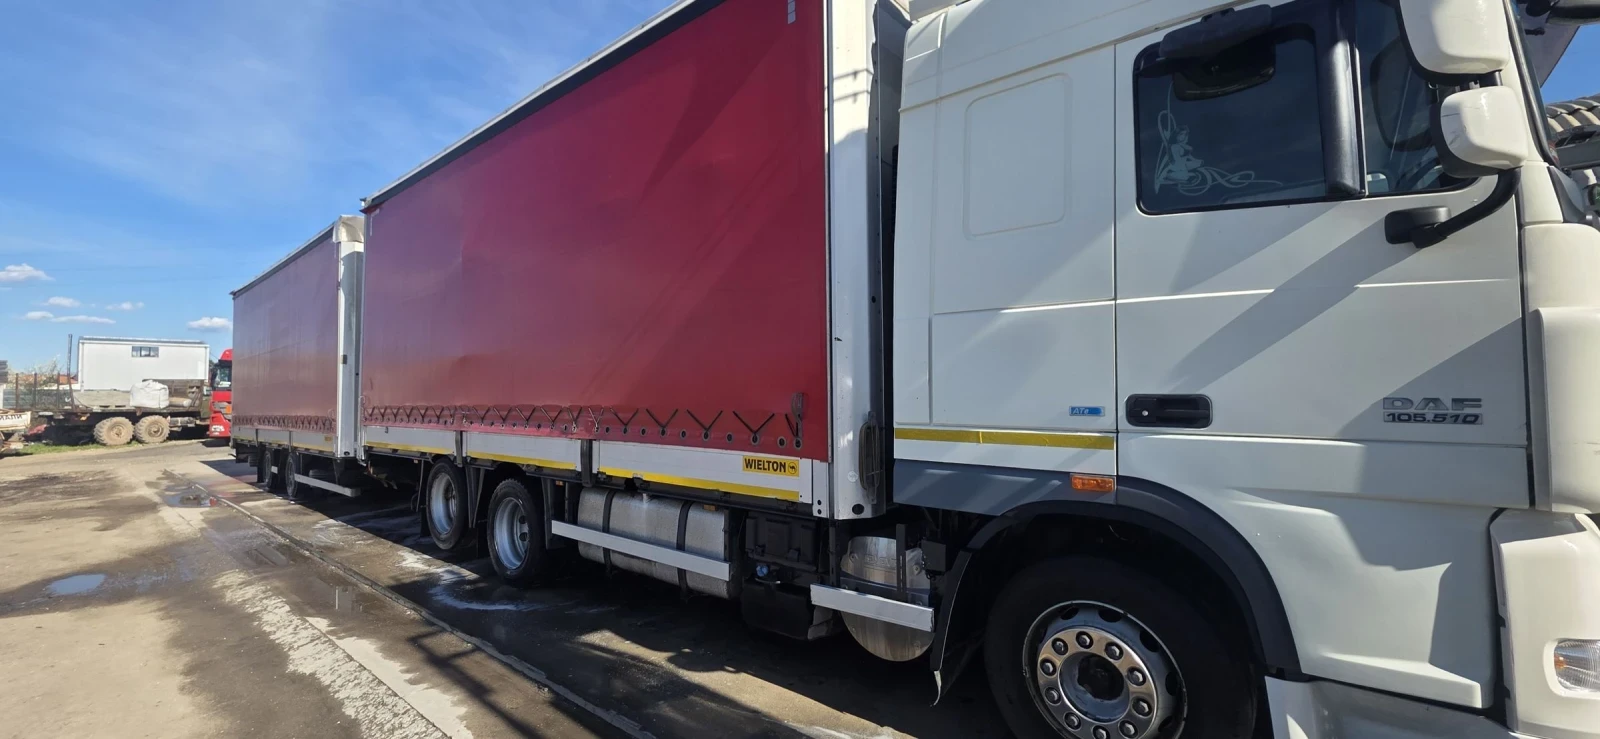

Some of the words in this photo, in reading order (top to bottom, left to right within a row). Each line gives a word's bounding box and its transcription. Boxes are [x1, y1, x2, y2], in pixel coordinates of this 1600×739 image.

[1382, 397, 1482, 411] DAF
[1386, 412, 1481, 424] 105.510
[744, 458, 787, 473] WIELTON
